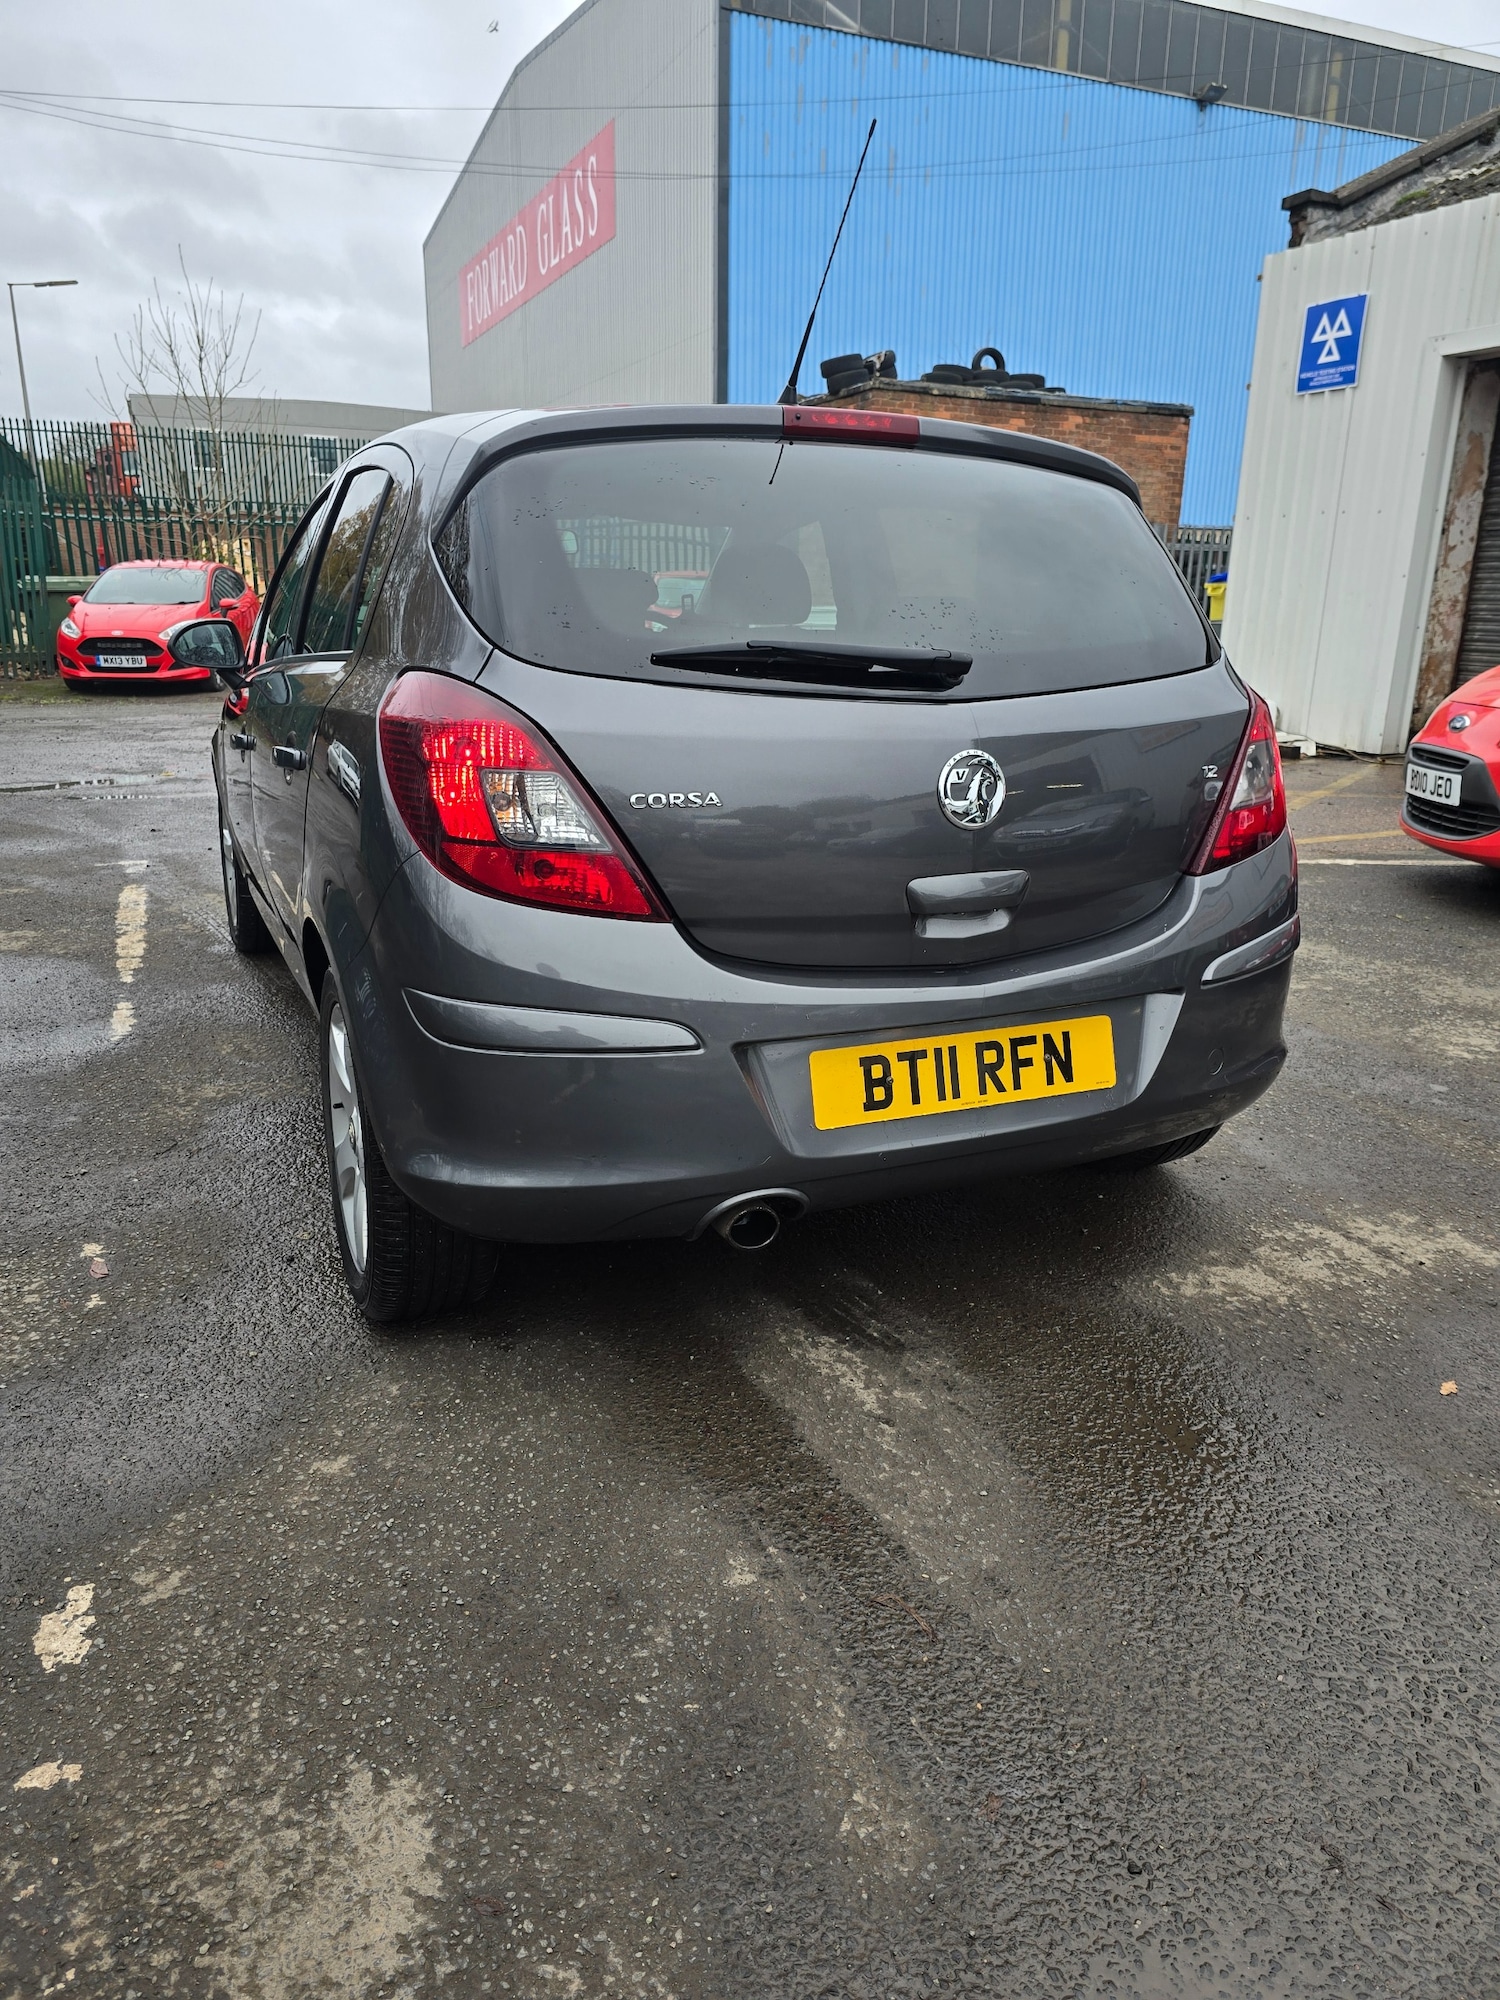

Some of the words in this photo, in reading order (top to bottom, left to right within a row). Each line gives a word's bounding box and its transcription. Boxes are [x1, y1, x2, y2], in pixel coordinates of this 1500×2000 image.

[466, 224, 528, 331] FORWARD
[536, 153, 599, 276] GLASS
[125, 656, 143, 666] YBU
[629, 792, 723, 809] CORSA
[859, 1045, 960, 1112] BT11
[975, 1030, 1074, 1096] RFN
